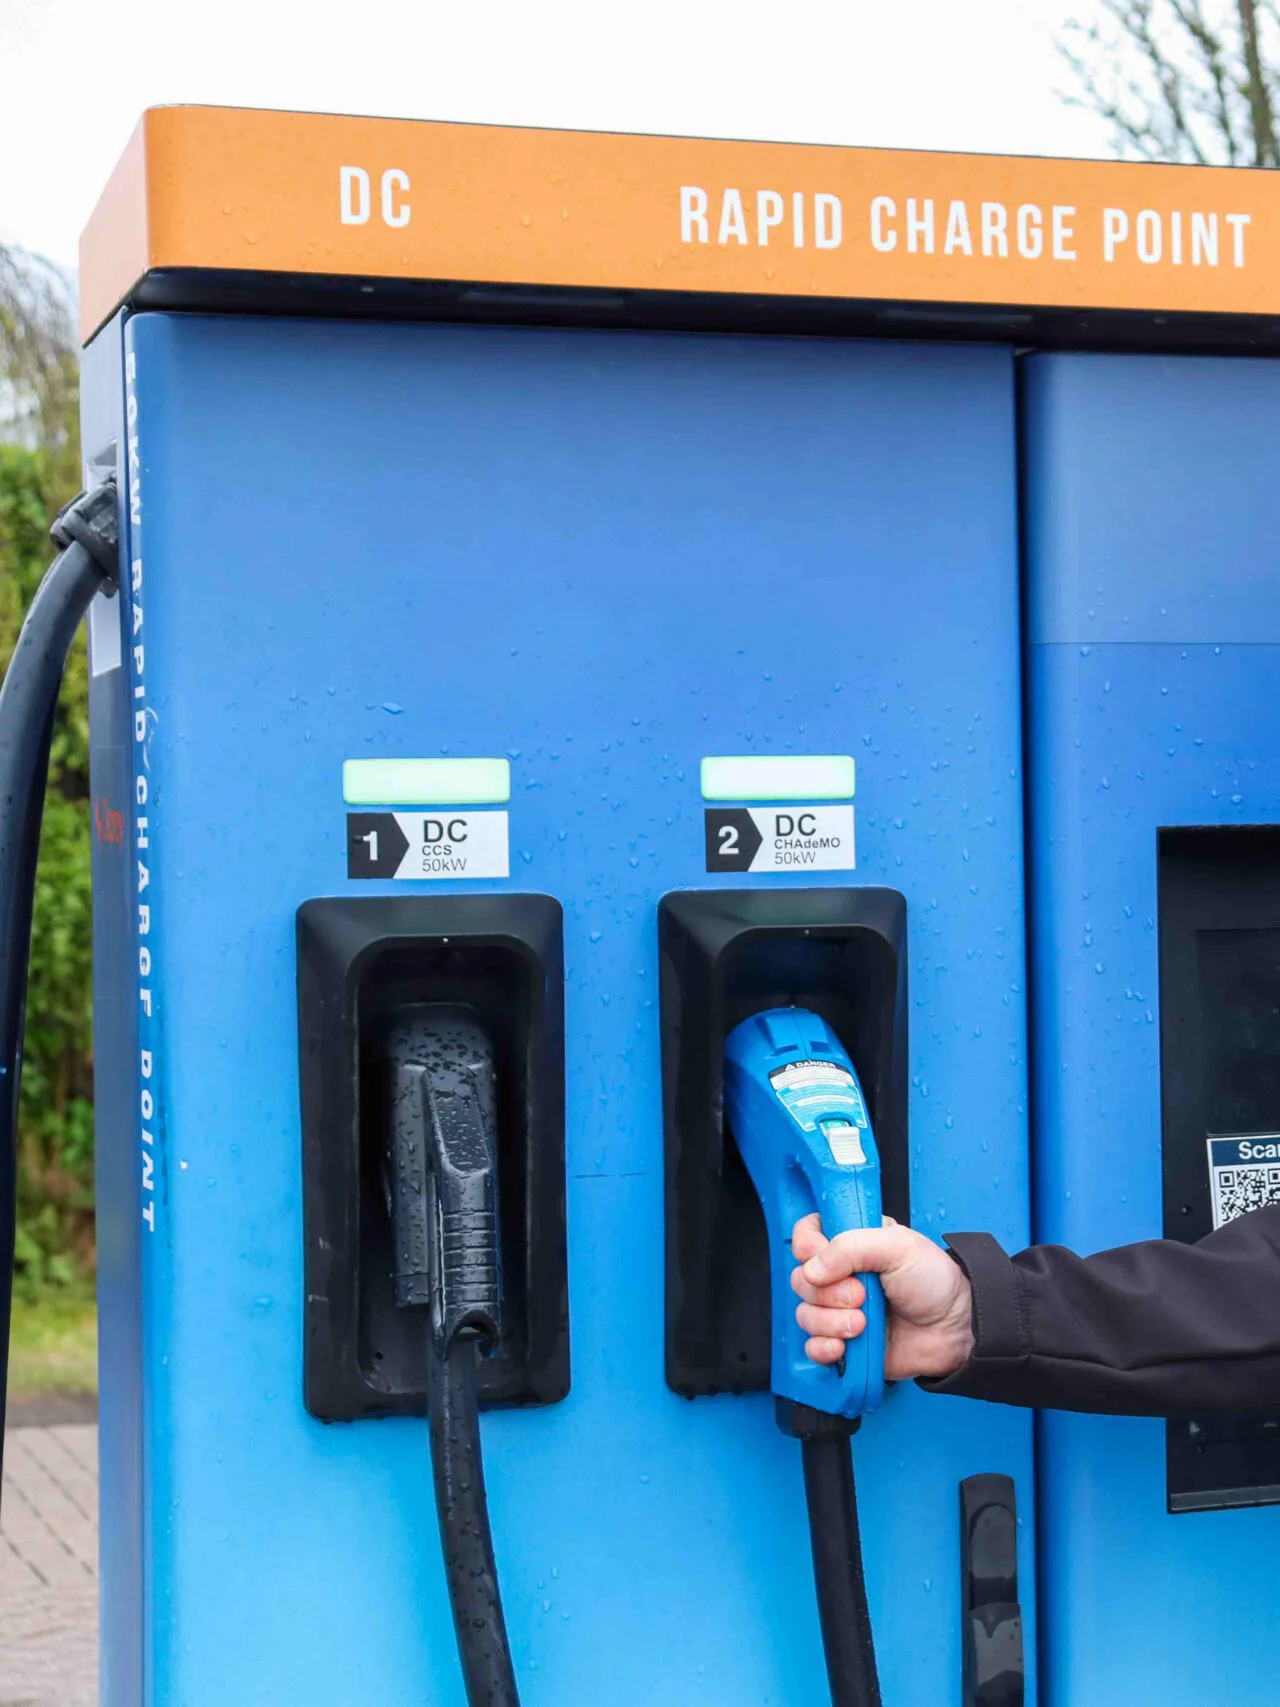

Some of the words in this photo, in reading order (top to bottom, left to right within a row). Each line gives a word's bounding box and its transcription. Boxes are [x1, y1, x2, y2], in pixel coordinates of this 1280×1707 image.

[339, 165, 411, 229] DC
[679, 185, 843, 250] RAPID
[870, 194, 1077, 261] CHARGE
[1102, 207, 1252, 269] POINT
[131, 558, 146, 742] RAPID
[423, 818, 469, 843] DC
[775, 813, 817, 837] DC
[362, 830, 379, 861] 1
[421, 844, 453, 857] CCS
[717, 825, 740, 855] 2
[774, 837, 841, 850] CHAdeMO
[421, 858, 467, 872] 50kW
[775, 851, 817, 865] 50kW
